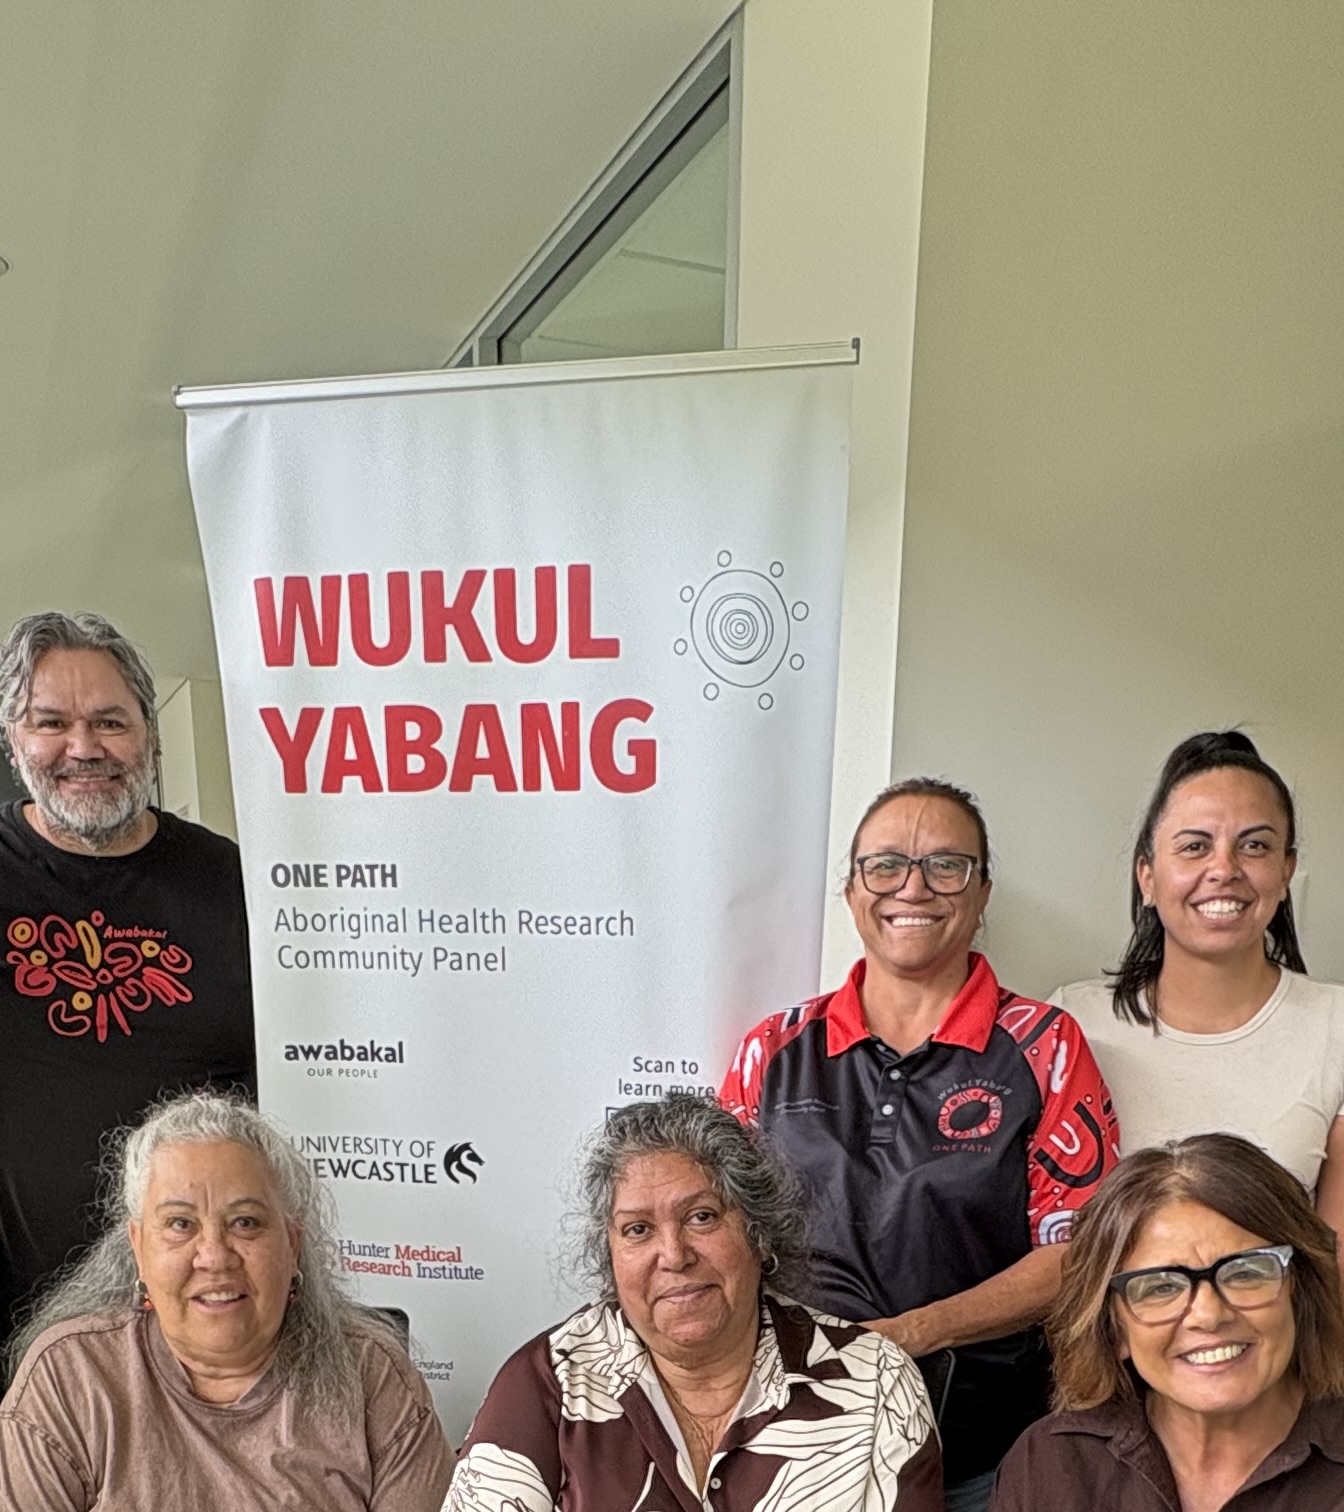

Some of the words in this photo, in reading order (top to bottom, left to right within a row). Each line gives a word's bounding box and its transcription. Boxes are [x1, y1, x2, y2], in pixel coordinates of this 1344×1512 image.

[253, 564, 621, 668] WUKUL
[258, 697, 658, 794] YABANG
[270, 863, 329, 889] ONE
[336, 863, 398, 889] PATH
[102, 924, 168, 939] Awabakal
[274, 906, 408, 940] Aboriginal
[417, 908, 507, 935] Health
[518, 909, 635, 937] Research
[277, 944, 424, 977] Community
[432, 947, 507, 972] Panel
[283, 1039, 404, 1065] awabakal
[306, 1067, 333, 1077] OUR
[337, 1068, 379, 1079] PEOPLE
[632, 1056, 675, 1073] Scan
[681, 1059, 699, 1075] to
[618, 1078, 663, 1096] learn
[670, 1084, 716, 1098] more
[409, 1140, 436, 1159] OF
[961, 1143, 992, 1153] PATH
[338, 1239, 391, 1259] Hunter
[395, 1244, 463, 1263] Medical
[340, 1256, 413, 1278] Research
[416, 1262, 485, 1281] Institute
